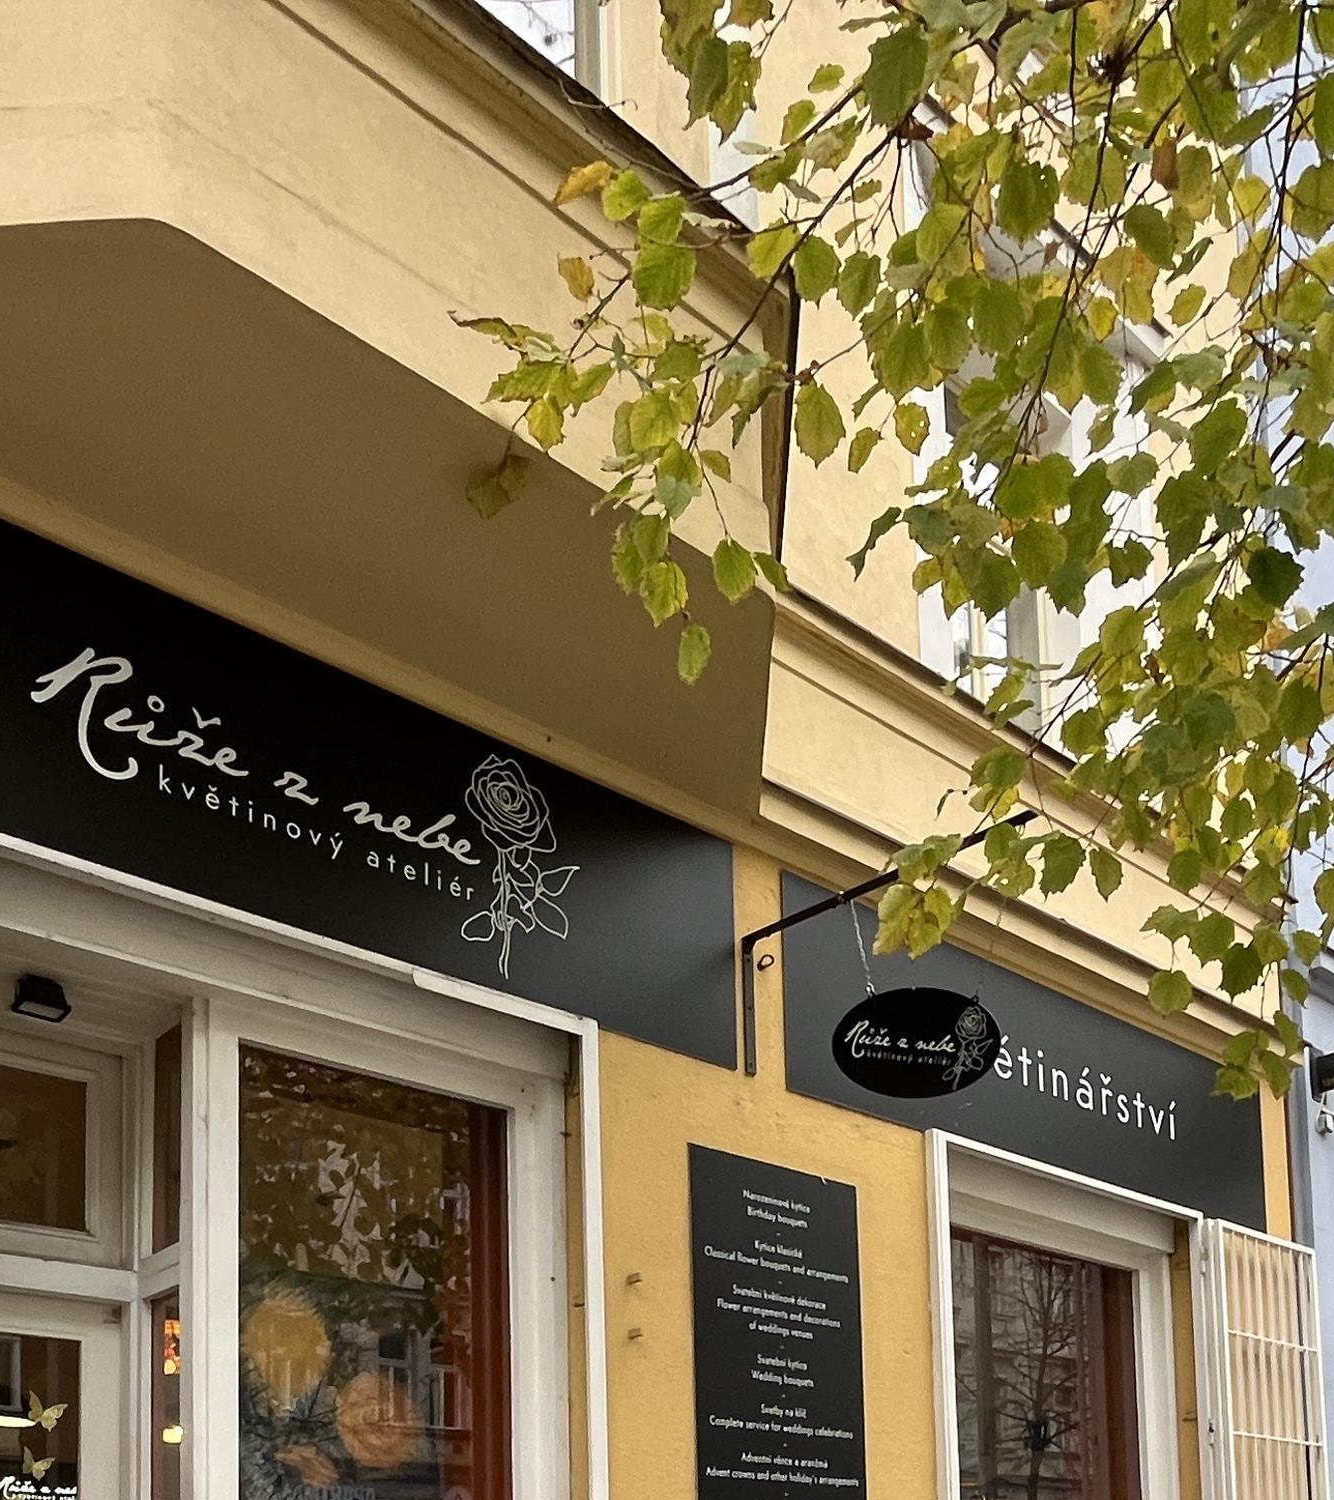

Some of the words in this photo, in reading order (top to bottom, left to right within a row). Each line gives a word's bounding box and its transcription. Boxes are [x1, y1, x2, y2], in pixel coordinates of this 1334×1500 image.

[31, 647, 249, 780] Růže
[273, 771, 319, 806] z
[342, 801, 481, 865] nebe
[159, 764, 343, 859] květinový
[366, 851, 475, 901] ateliér
[844, 1020, 891, 1058] Růže
[915, 1034, 956, 1052] nebe
[993, 1035, 1176, 1141] ětinářství
